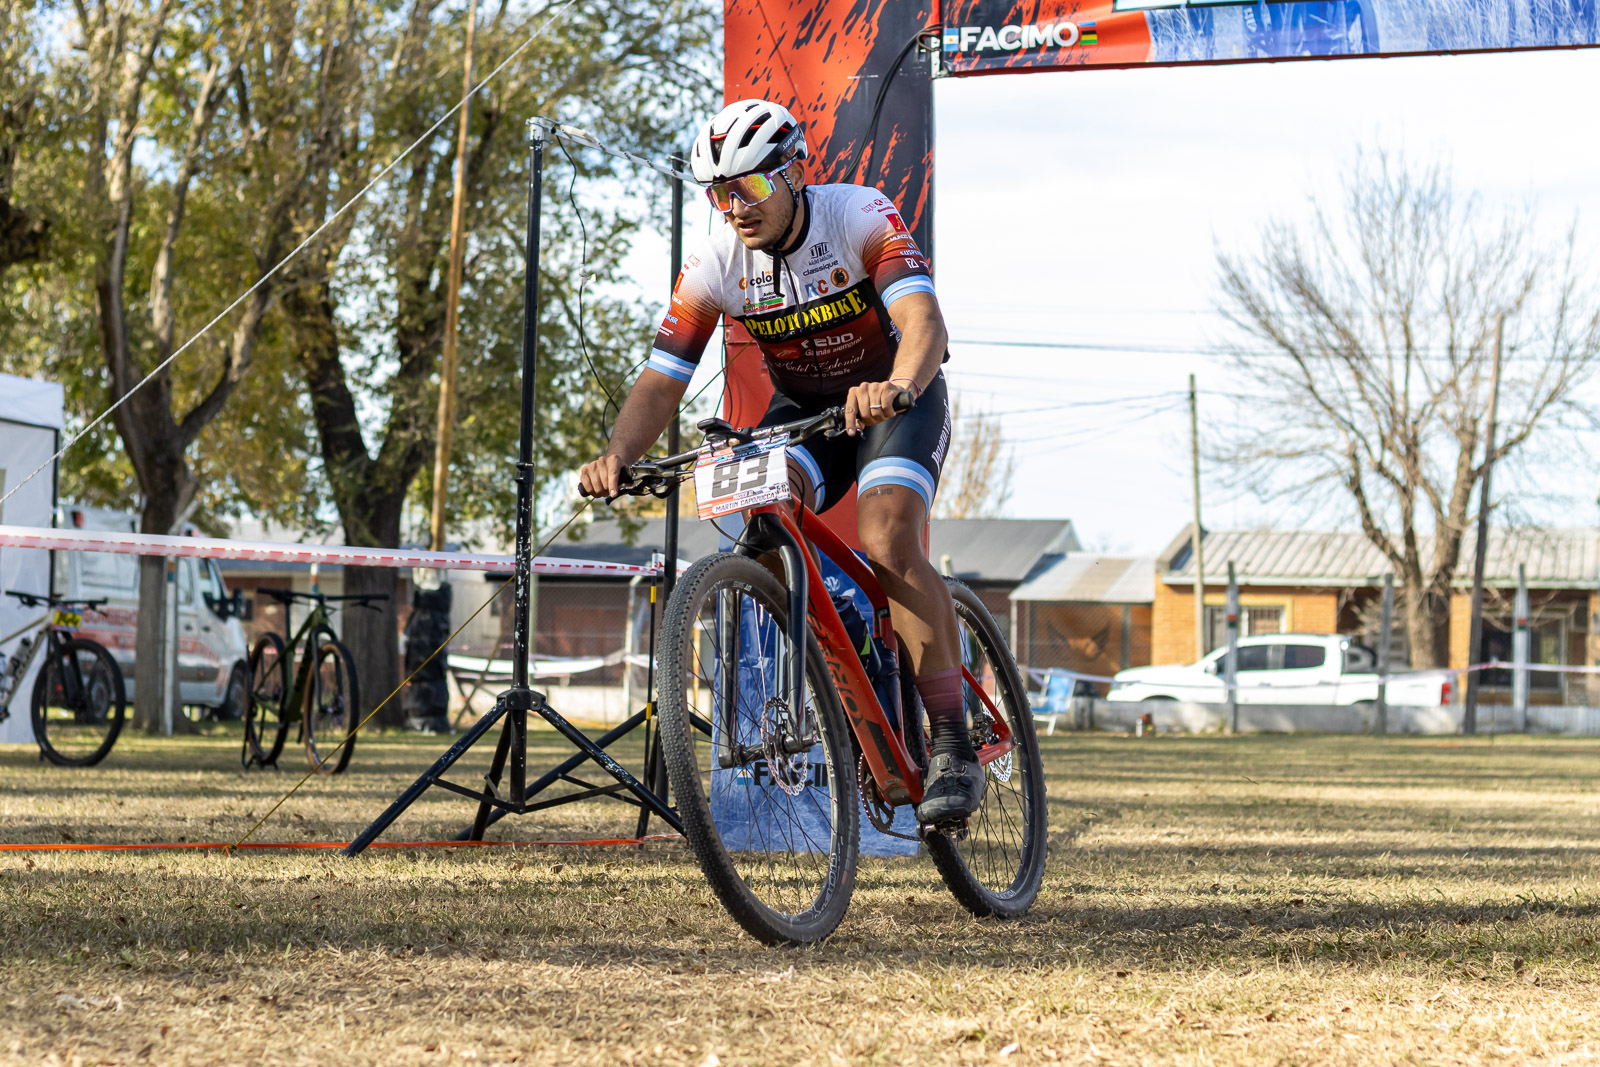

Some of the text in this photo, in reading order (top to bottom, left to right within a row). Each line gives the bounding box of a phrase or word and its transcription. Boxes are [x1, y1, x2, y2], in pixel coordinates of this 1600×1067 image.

[960, 22, 1079, 52] FACIMO
[749, 270, 774, 287] colo
[803, 260, 839, 277] classique
[712, 451, 770, 498] 83
